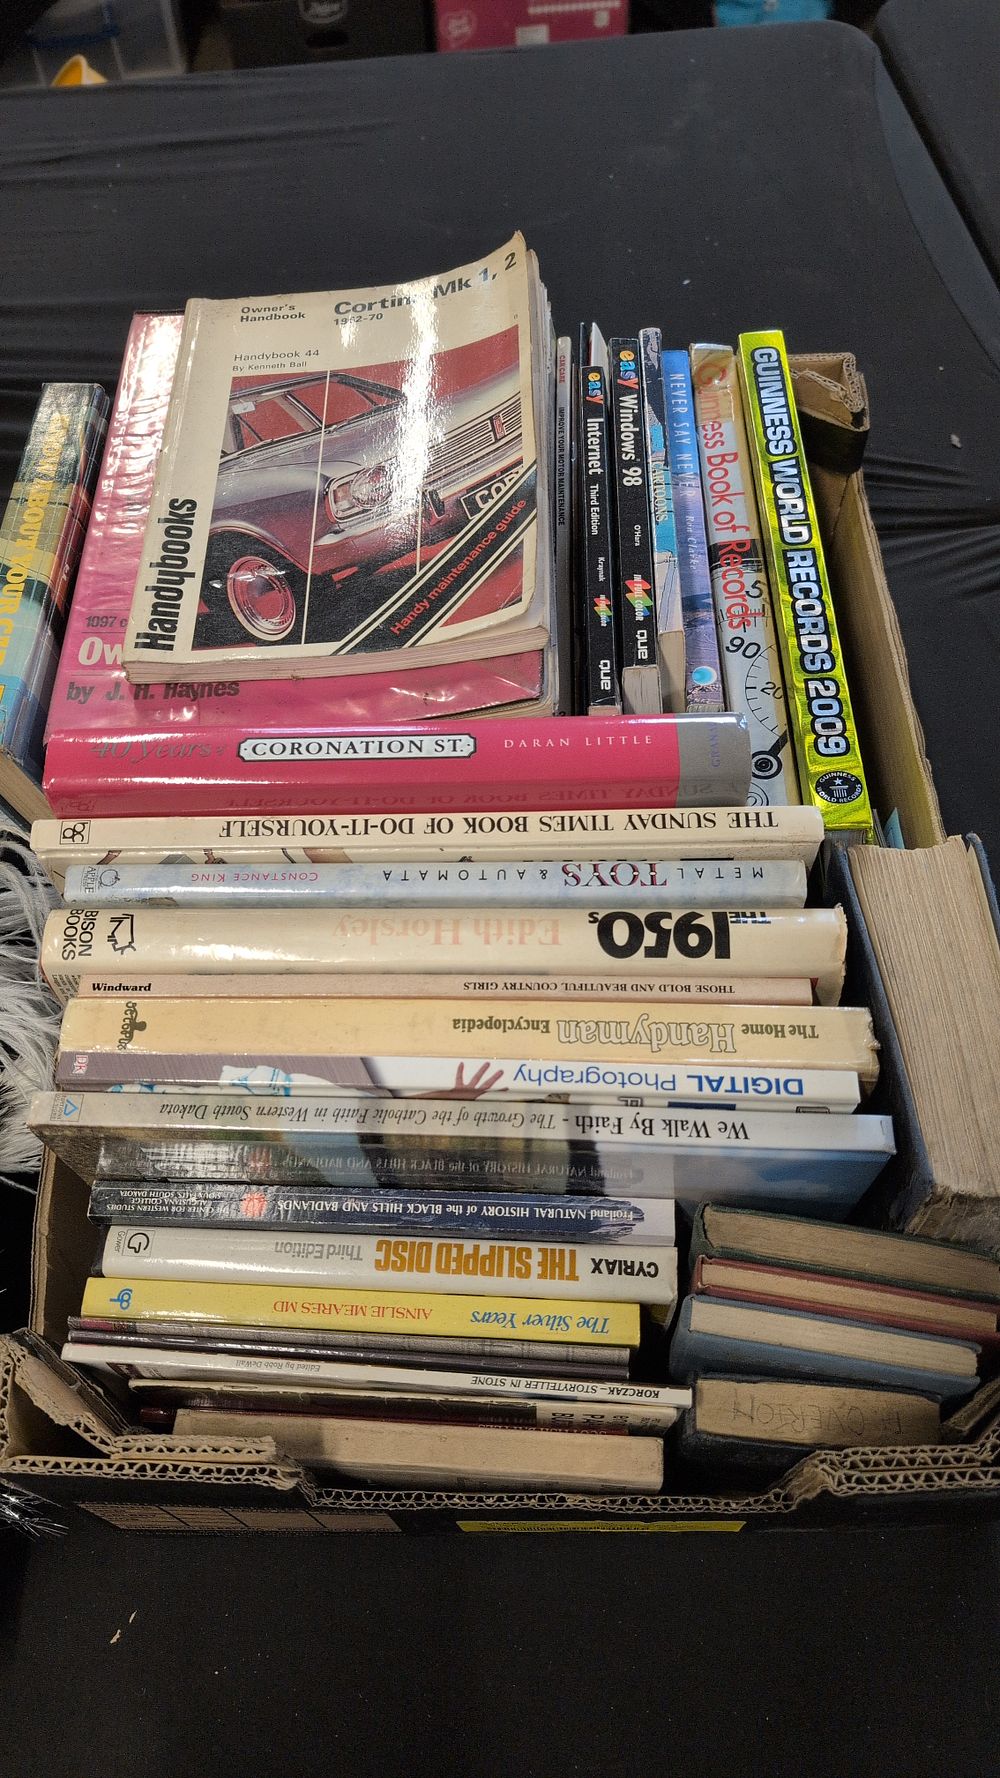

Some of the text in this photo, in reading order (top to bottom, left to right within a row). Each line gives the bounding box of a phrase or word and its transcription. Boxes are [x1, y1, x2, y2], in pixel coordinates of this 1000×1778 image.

[334, 294, 422, 315] Cortin
[433, 277, 472, 299] Mk
[504, 251, 517, 270] 2
[240, 311, 306, 323] Handbook
[241, 303, 296, 314] Owner's
[232, 361, 307, 373] By Kenneth Ball
[234, 348, 320, 363] Handybook 44
[586, 372, 604, 475] easy Internet
[617, 350, 643, 487] easy Windows 98
[669, 373, 696, 497] NEVER SAY NEVER
[707, 452, 746, 507] Book
[558, 477, 566, 526] MAINTENANCE
[590, 484, 600, 535] Third Edition
[633, 524, 642, 547] O'Hara
[713, 510, 750, 538] of
[751, 345, 851, 757] GUINNESS WORLD RECORDS 2009
[135, 496, 198, 651] Handybooks
[390, 499, 527, 636] Handy maintenance guide
[596, 557, 606, 582] Kraynak
[718, 539, 766, 631] Records
[85, 615, 117, 628] 1097
[78, 636, 123, 665] Ow
[725, 635, 762, 660] 90
[67, 682, 95, 704] by
[163, 681, 240, 702] Haynes
[251, 738, 465, 756] CORONATION ST.
[504, 735, 654, 749] DARAN LITTLE
[219, 810, 779, 838] THE SUNDAY TIMES BOOK OF DO-IT-YOURSELF
[191, 871, 318, 883] CONSTANCE KING
[382, 862, 764, 887] METAL TOYS & AUTOMATA
[61, 908, 84, 961] BOOKS
[78, 910, 99, 957] BISON
[332, 913, 561, 946] Edith Horsley
[92, 982, 152, 992] Windward
[464, 982, 735, 994] THOSE BOLD AND BEAUTIFUL COUNTRY GIRLS
[453, 1013, 819, 1053] The Home Handyman Encyclopedia
[73, 1055, 89, 1074] DK
[512, 1063, 804, 1096] DIGITAL Photography
[159, 1103, 750, 1140] We Walk By Faith The Growth of the Catholic Faith in Western South Dakota
[119, 1190, 148, 1198] DAKOTA
[137, 1204, 170, 1212] WESTERN
[171, 1205, 186, 1213] FOR
[278, 1200, 634, 1220] Froiland NATURAL HISTORY of the BLACK HILLS AND BADLANDS
[114, 1231, 125, 1253] Gower
[274, 1240, 363, 1261] Third Edition
[374, 1239, 659, 1281] CYRIAX THE SLIPPED DISC
[273, 1300, 433, 1320] AINSLIE MEARES MD
[471, 1310, 610, 1334] The Silver Years
[264, 1361, 284, 1370] Robb
[298, 1363, 321, 1373] Edited
[471, 1375, 598, 1394] STORYTELLER IN STONE
